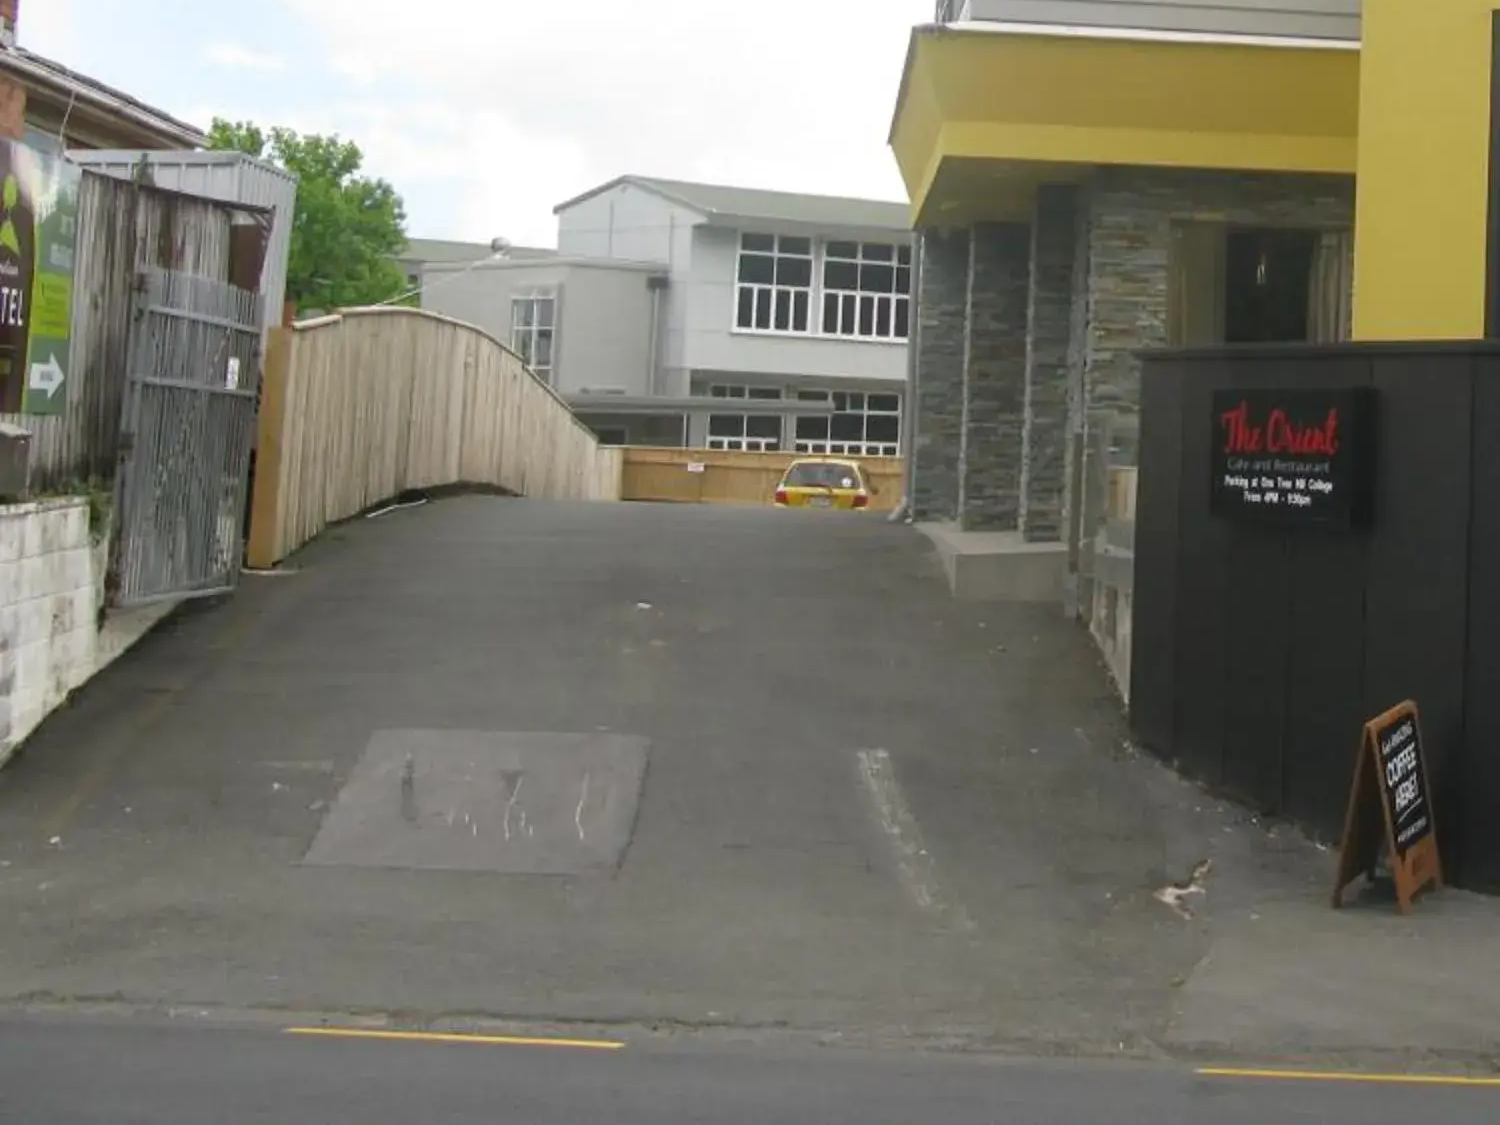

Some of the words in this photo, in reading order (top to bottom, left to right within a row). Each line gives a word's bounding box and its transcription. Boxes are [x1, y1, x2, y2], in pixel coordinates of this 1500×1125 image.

[1221, 400, 1262, 454] The
[1267, 408, 1340, 457] Orient
[1386, 742, 1417, 787] COFFEE
